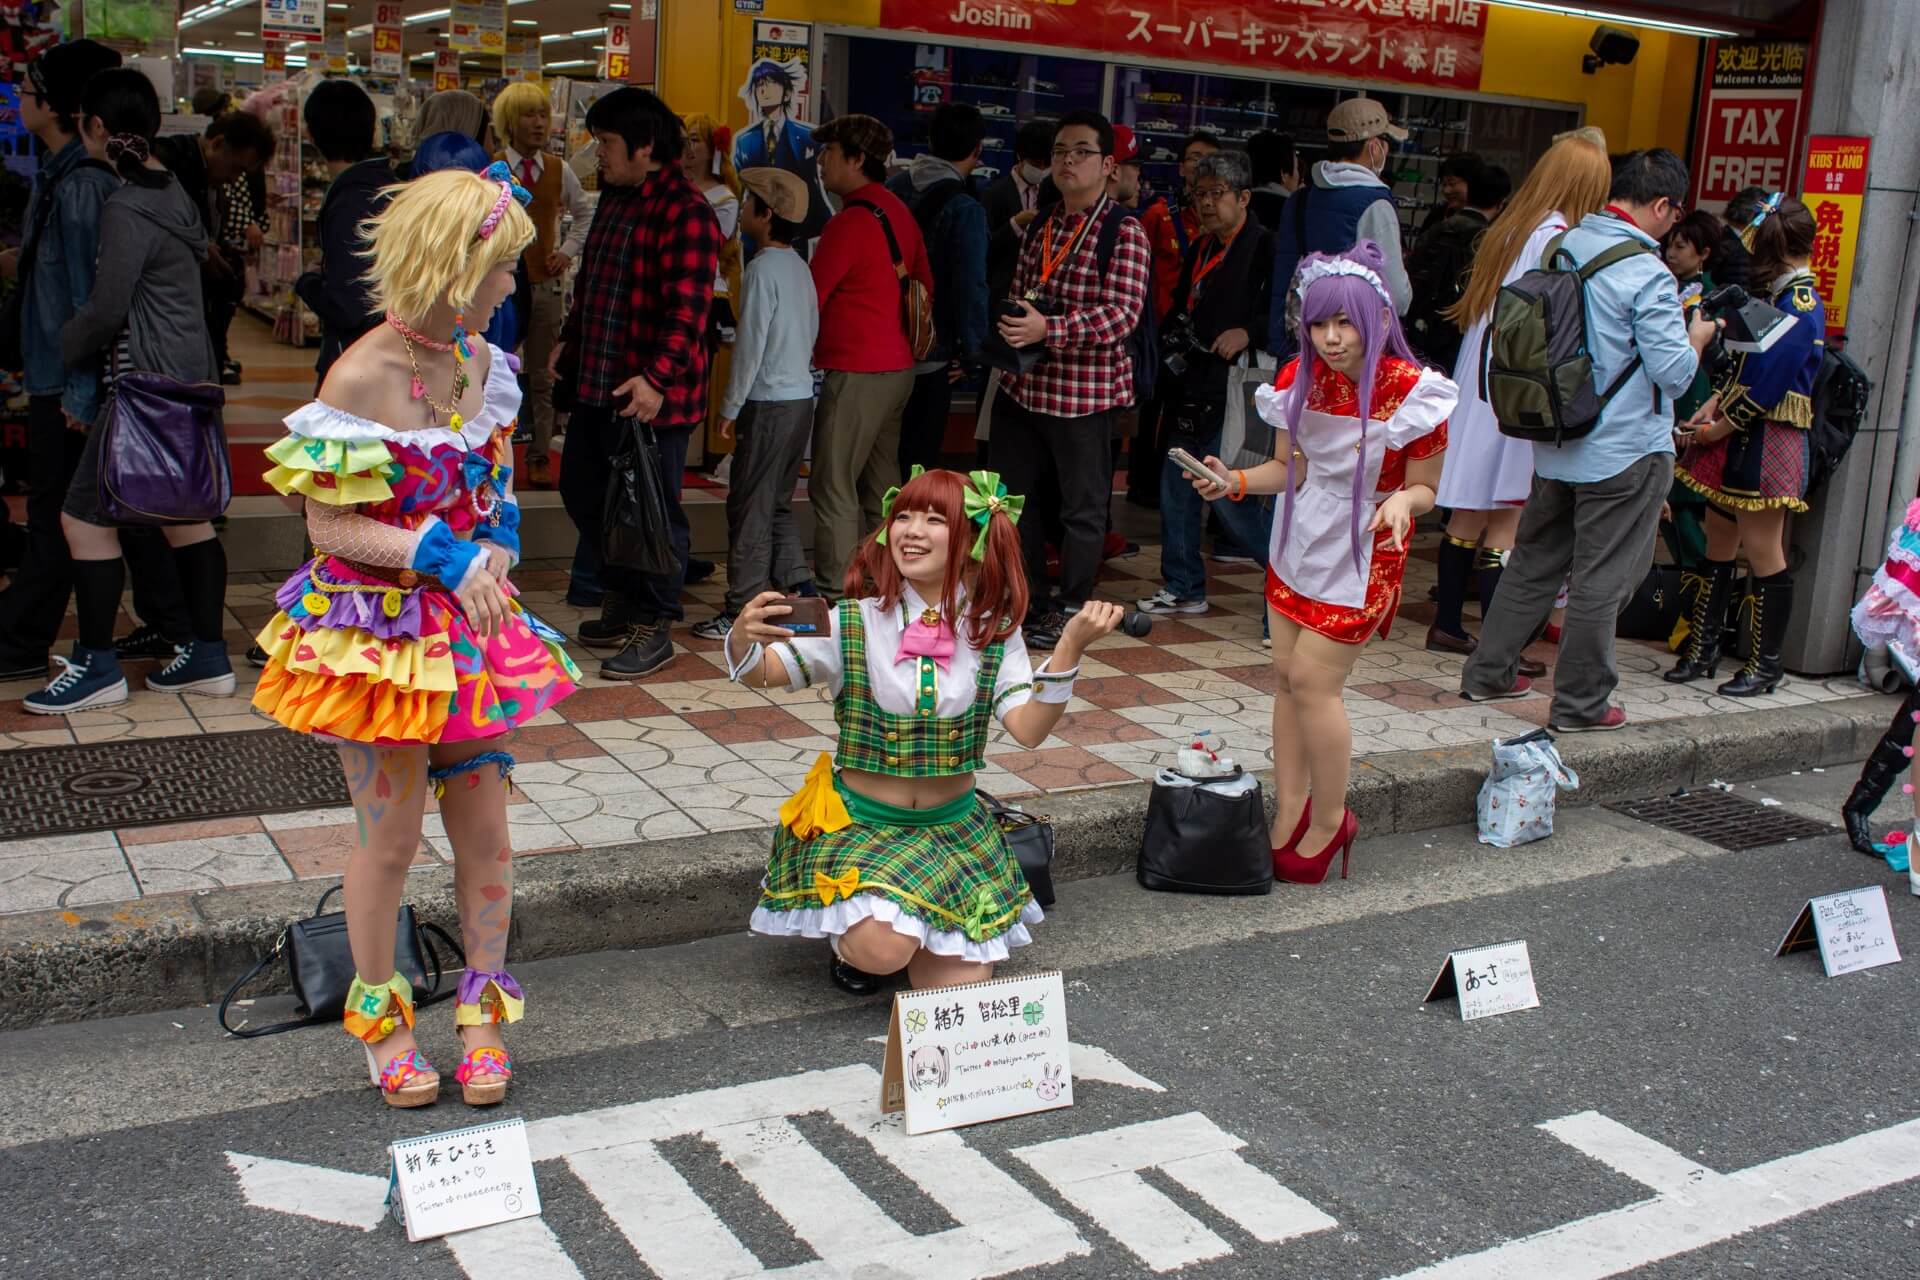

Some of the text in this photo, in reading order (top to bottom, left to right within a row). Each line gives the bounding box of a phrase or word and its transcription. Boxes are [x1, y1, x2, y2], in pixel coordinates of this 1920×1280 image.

[951, 1, 1032, 30] Joshin
[1275, 0, 1480, 28] 型専門店
[1127, 10, 1458, 78] スーパーキッズランド本店
[1716, 44, 1804, 72] 欢迎光临
[1715, 73, 1802, 84] Welcome to Joshin
[1720, 107, 1785, 145] TAX
[1706, 155, 1785, 192] FREE
[1809, 153, 1864, 169] KIDS LAND
[1810, 200, 1843, 302] 免税店
[934, 996, 1021, 1032] 緒方 智絵里
